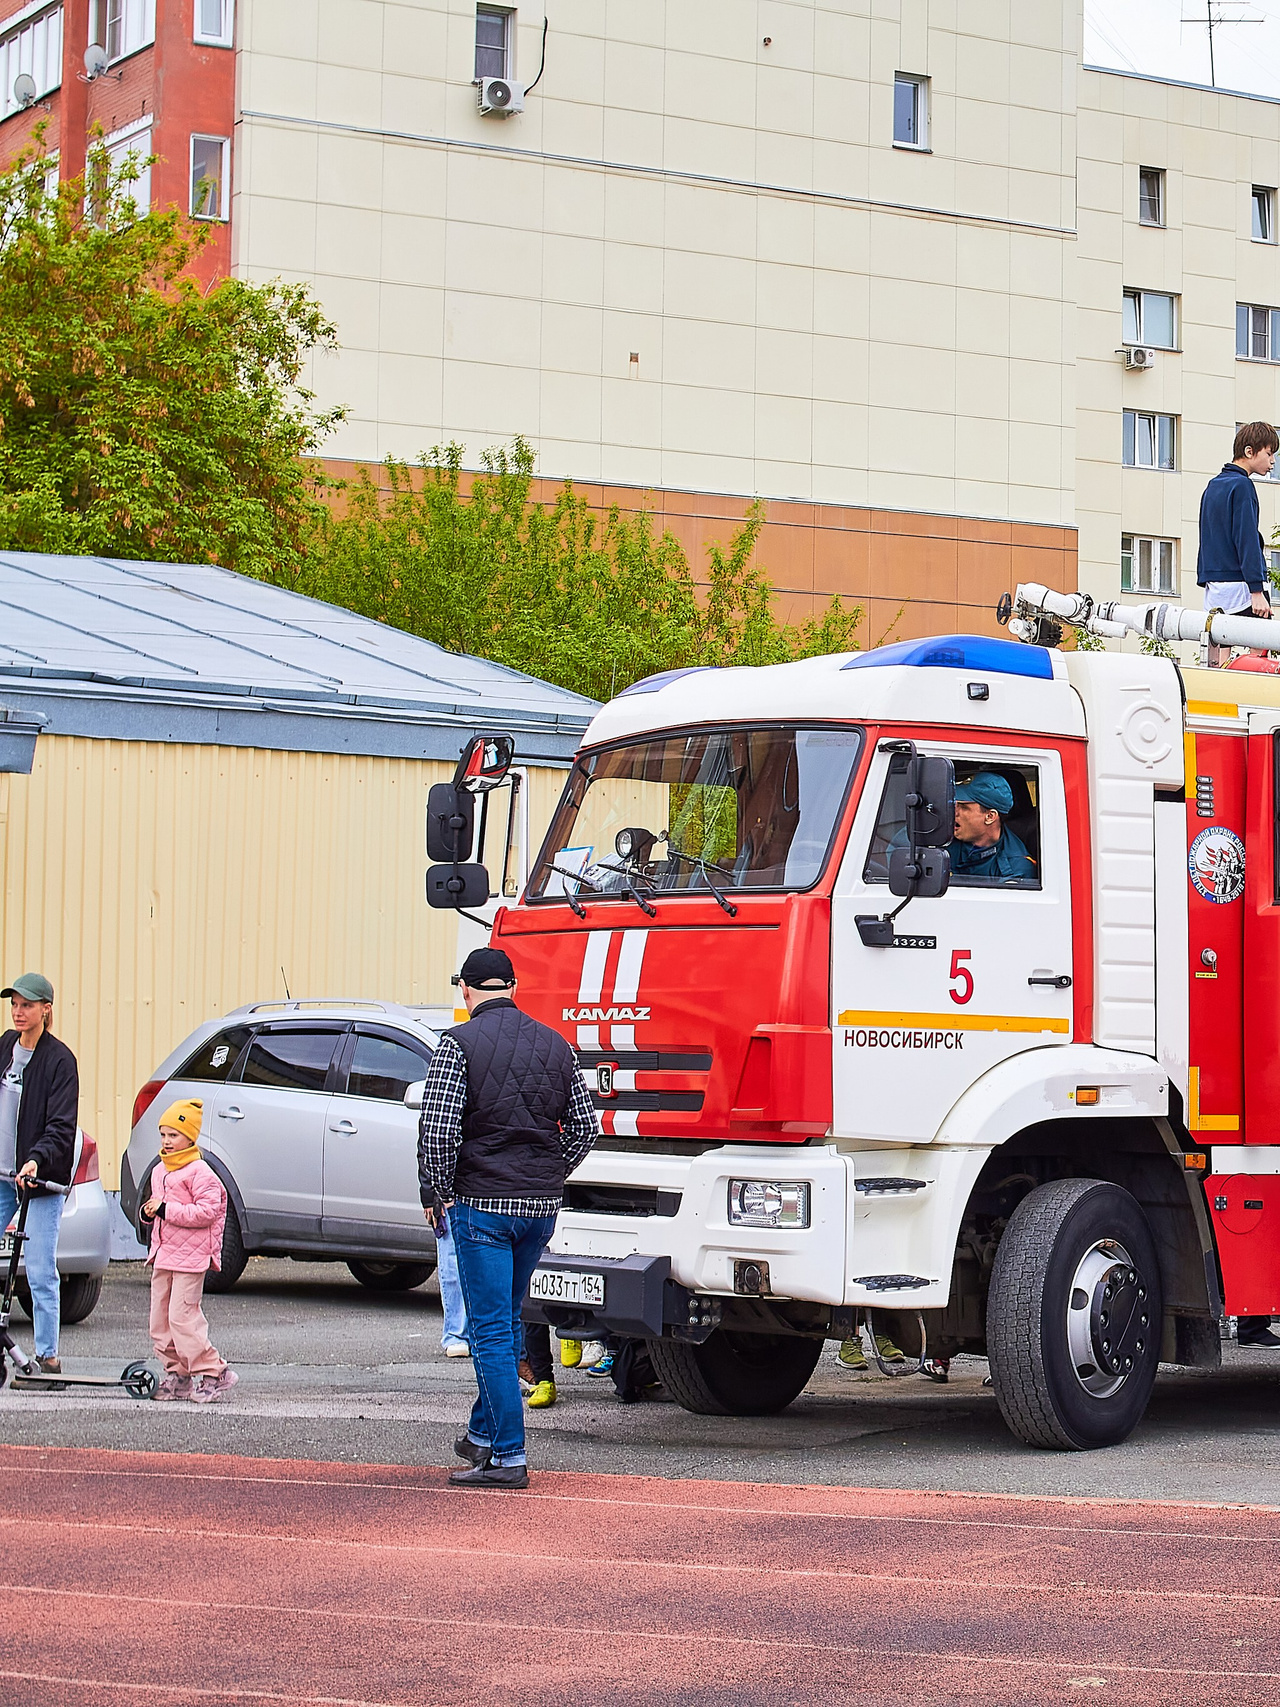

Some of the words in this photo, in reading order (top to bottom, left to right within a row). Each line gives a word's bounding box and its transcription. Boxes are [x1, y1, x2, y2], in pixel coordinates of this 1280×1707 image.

[1189, 829, 1210, 867] ПОЖАРНОЙ
[1210, 827, 1236, 841] ОХРАНЕ
[892, 938, 935, 947] 43265
[949, 950, 974, 1005] 5
[562, 1007, 651, 1021] KAMAZ
[844, 1029, 964, 1049] НОВОСИБИРСК
[534, 1274, 578, 1298] Н033ТТ
[582, 1276, 602, 1294] 154
